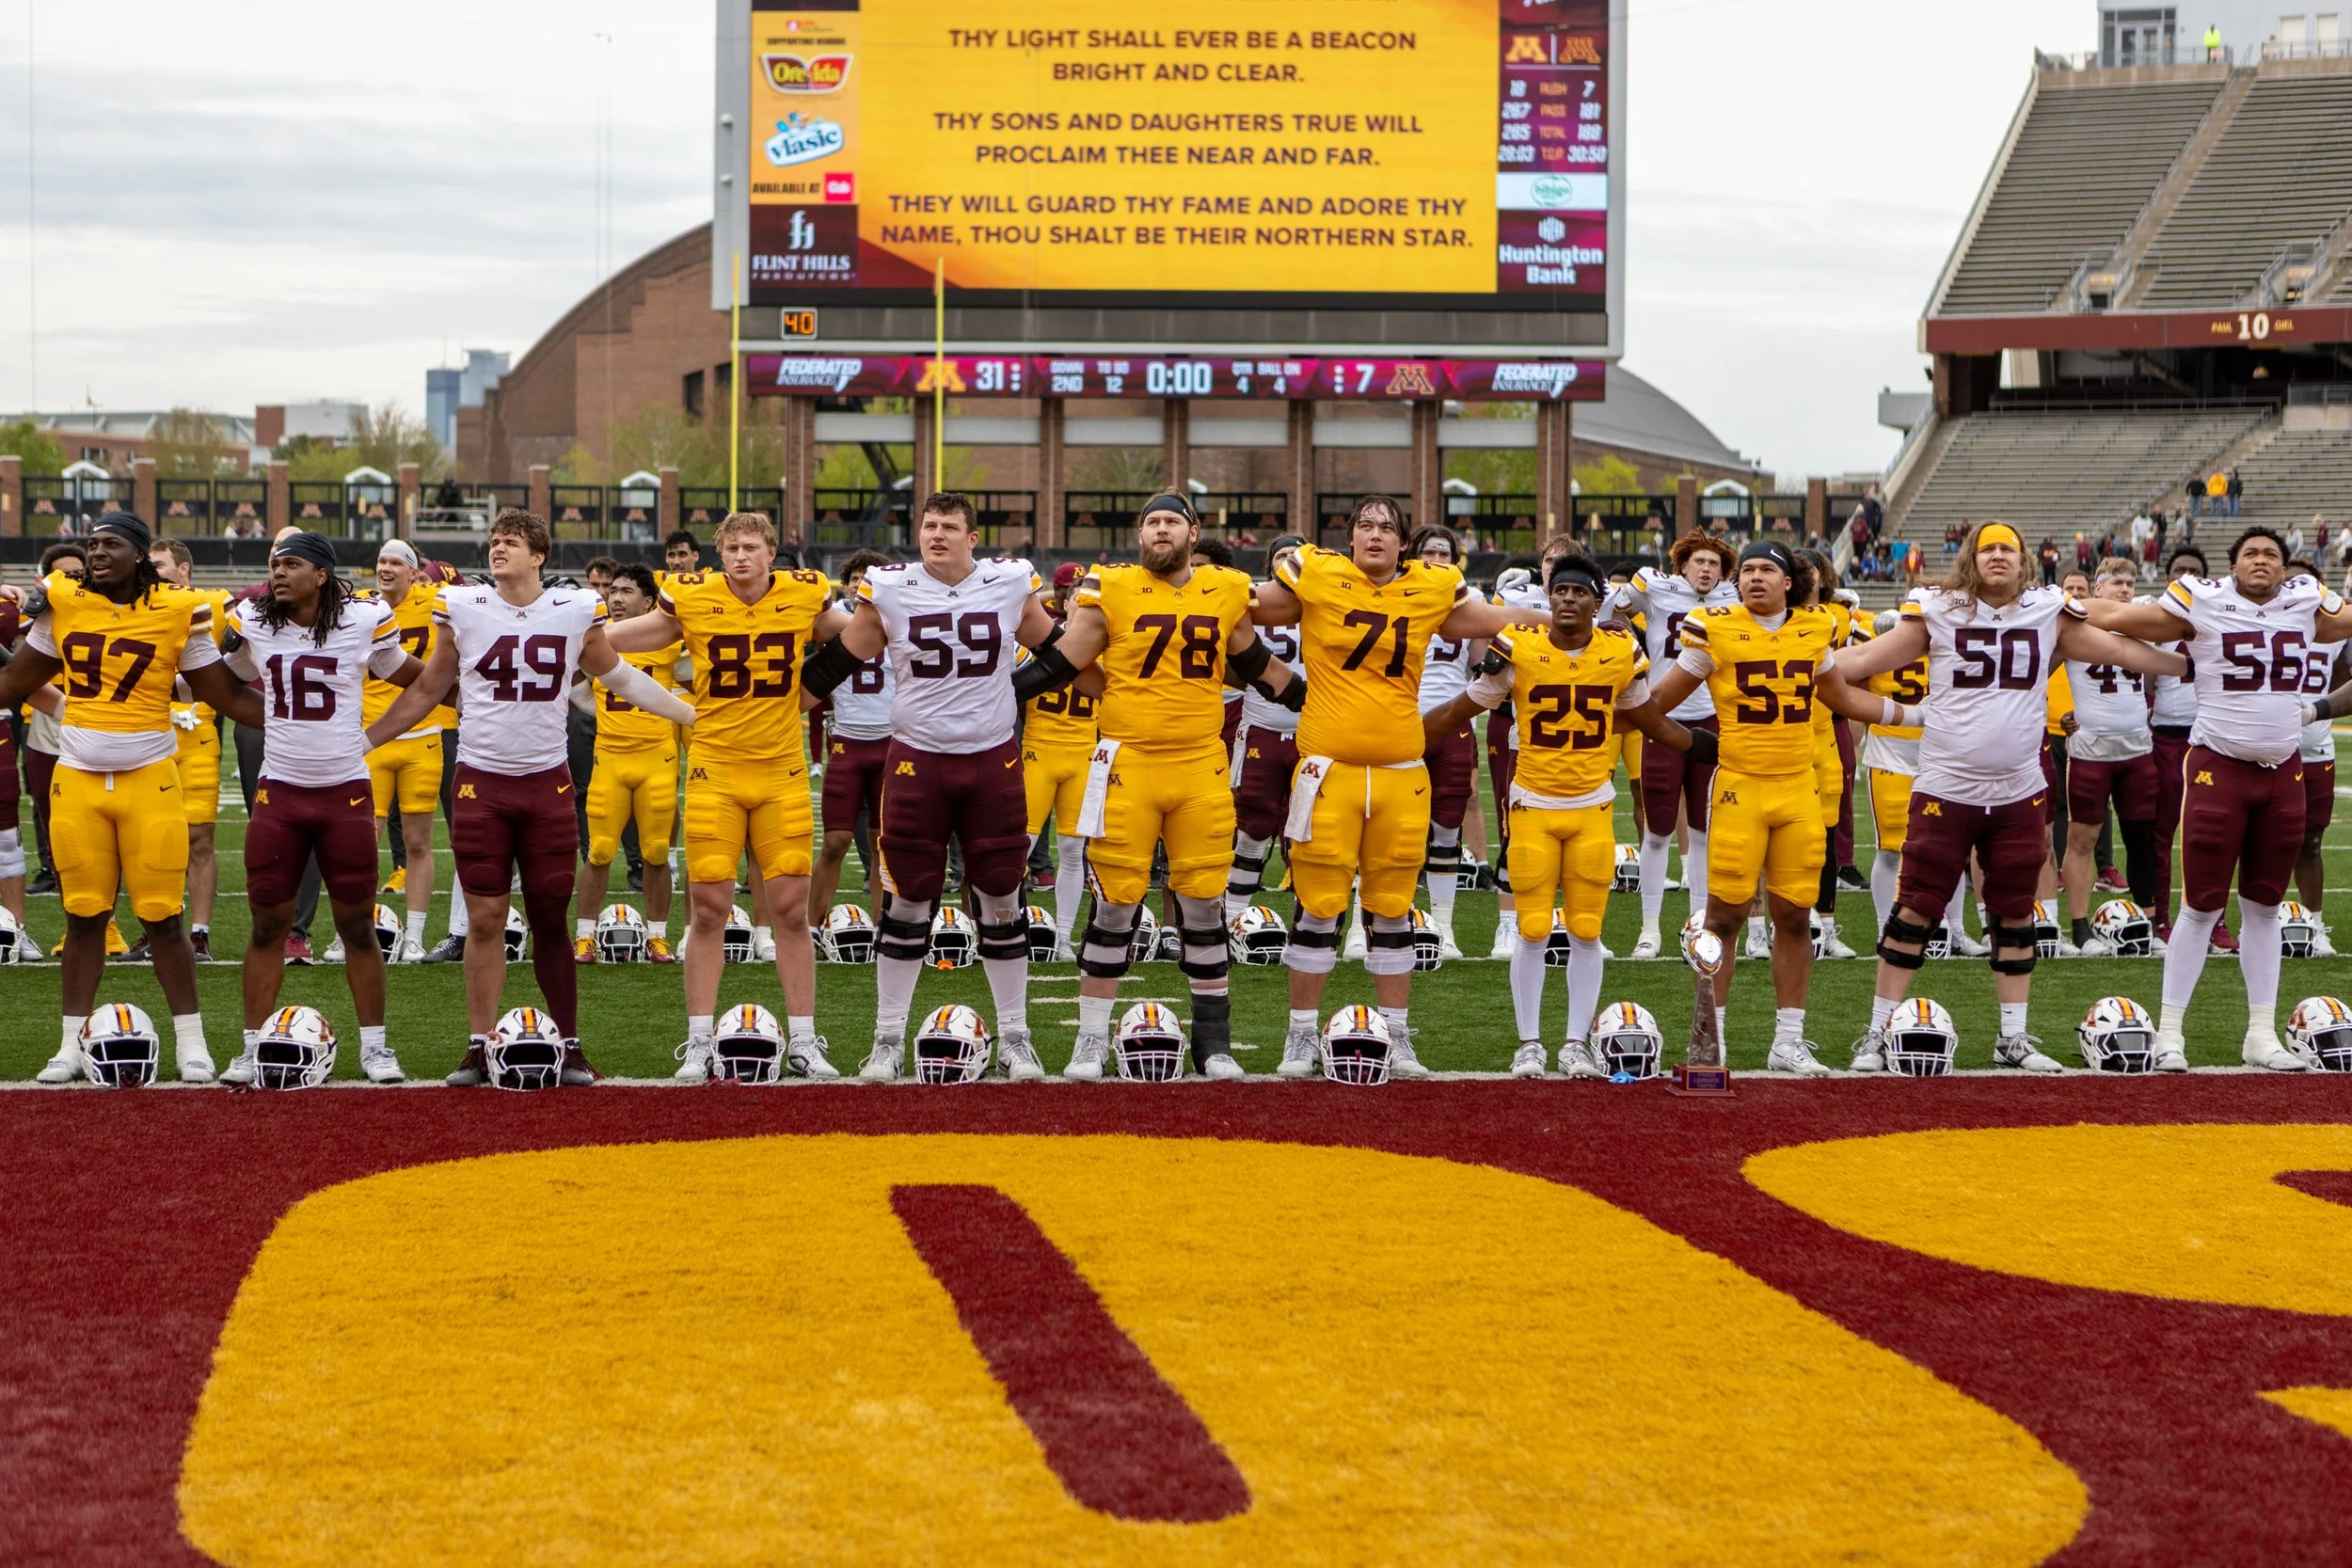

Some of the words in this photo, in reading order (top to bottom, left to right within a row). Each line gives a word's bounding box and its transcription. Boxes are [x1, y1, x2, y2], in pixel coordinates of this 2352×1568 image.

[949, 30, 997, 47] THY
[1008, 30, 1078, 48] LIGHT
[1089, 30, 1165, 48] SHALL
[1176, 31, 1237, 48] EVER
[1248, 32, 1277, 48] BE
[1287, 32, 1302, 48] A
[1311, 32, 1415, 50] BEACON
[1054, 63, 1145, 81] BRIGHT
[1155, 64, 1208, 81] AND
[1217, 64, 1304, 82] CLEAR.
[1582, 80, 1596, 98] 7
[934, 113, 981, 130] THY
[992, 113, 1058, 131] SONS
[1069, 114, 1121, 131] AND
[1132, 114, 1283, 133] DAUGHTERS
[1293, 115, 1356, 133] TRUE
[1366, 116, 1422, 133] WILL
[977, 146, 1105, 164] PROCLAIM
[1116, 147, 1177, 164] THEE
[1188, 147, 1253, 165] NEAR
[1263, 148, 1316, 165] AND
[1327, 148, 1380, 166] FAR.
[753, 182, 806, 194] AVAILABLE
[809, 182, 820, 194] AT
[889, 196, 952, 213] THEY
[961, 196, 1017, 213] WILL
[1027, 196, 1115, 214] GUARD
[1125, 197, 1173, 214] THY
[1184, 197, 1249, 214] FAME
[1259, 198, 1312, 214] AND
[1322, 198, 1407, 215] ADORE
[1418, 199, 1465, 215] THY
[882, 227, 961, 246] NAME,
[971, 227, 1040, 244] THOU
[1050, 227, 1126, 244] SHALT
[1136, 228, 1165, 244] BE
[1175, 228, 1246, 245] THEIR
[1256, 228, 1394, 245] NORTHERN
[1405, 229, 1473, 246] STAR.
[753, 255, 801, 271] FLINT
[803, 255, 850, 271] HILLS
[1499, 243, 1604, 266] Huntington
[1527, 264, 1577, 284] Bank
[784, 312, 814, 335] 40
[2211, 322, 2233, 333] PAUL
[2237, 313, 2269, 340] 10
[780, 358, 862, 377] FEDERATED
[976, 361, 1004, 390] 31
[1050, 361, 1084, 374] DOWN
[1097, 361, 1110, 374] TO
[1113, 361, 1129, 374] GO
[1232, 361, 1252, 374] QTR
[1257, 362, 1282, 375] BALL
[1284, 362, 1301, 375] ON
[1495, 363, 1578, 380] FEDERATED
[1052, 376, 1083, 392] 2ND
[1106, 376, 1122, 392] 12
[1147, 361, 1212, 394] 0:00
[1236, 377, 1248, 393] 4
[1274, 378, 1286, 393] 4
[1357, 363, 1375, 393] 7
[908, 611, 1002, 678] 59
[1133, 614, 1220, 679] 78
[1264, 625, 1304, 664] 5
[1341, 610, 1409, 677] 71
[62, 631, 157, 702] 97
[473, 634, 567, 702] 49
[707, 632, 795, 698] 83
[1954, 627, 2041, 690] 50
[2221, 631, 2307, 692] 56
[265, 654, 339, 721] 16
[1734, 659, 1815, 724] 53
[1893, 661, 1930, 705] 5
[1528, 684, 1613, 750] 25
[1093, 749, 1109, 764] M
[690, 768, 708, 780] M
[895, 761, 915, 776] M
[1300, 762, 1321, 779] M
[2194, 770, 2214, 785] M
[255, 789, 270, 805] M
[458, 784, 477, 799] M
[1719, 791, 1739, 805] M
[1922, 802, 1942, 816] M
